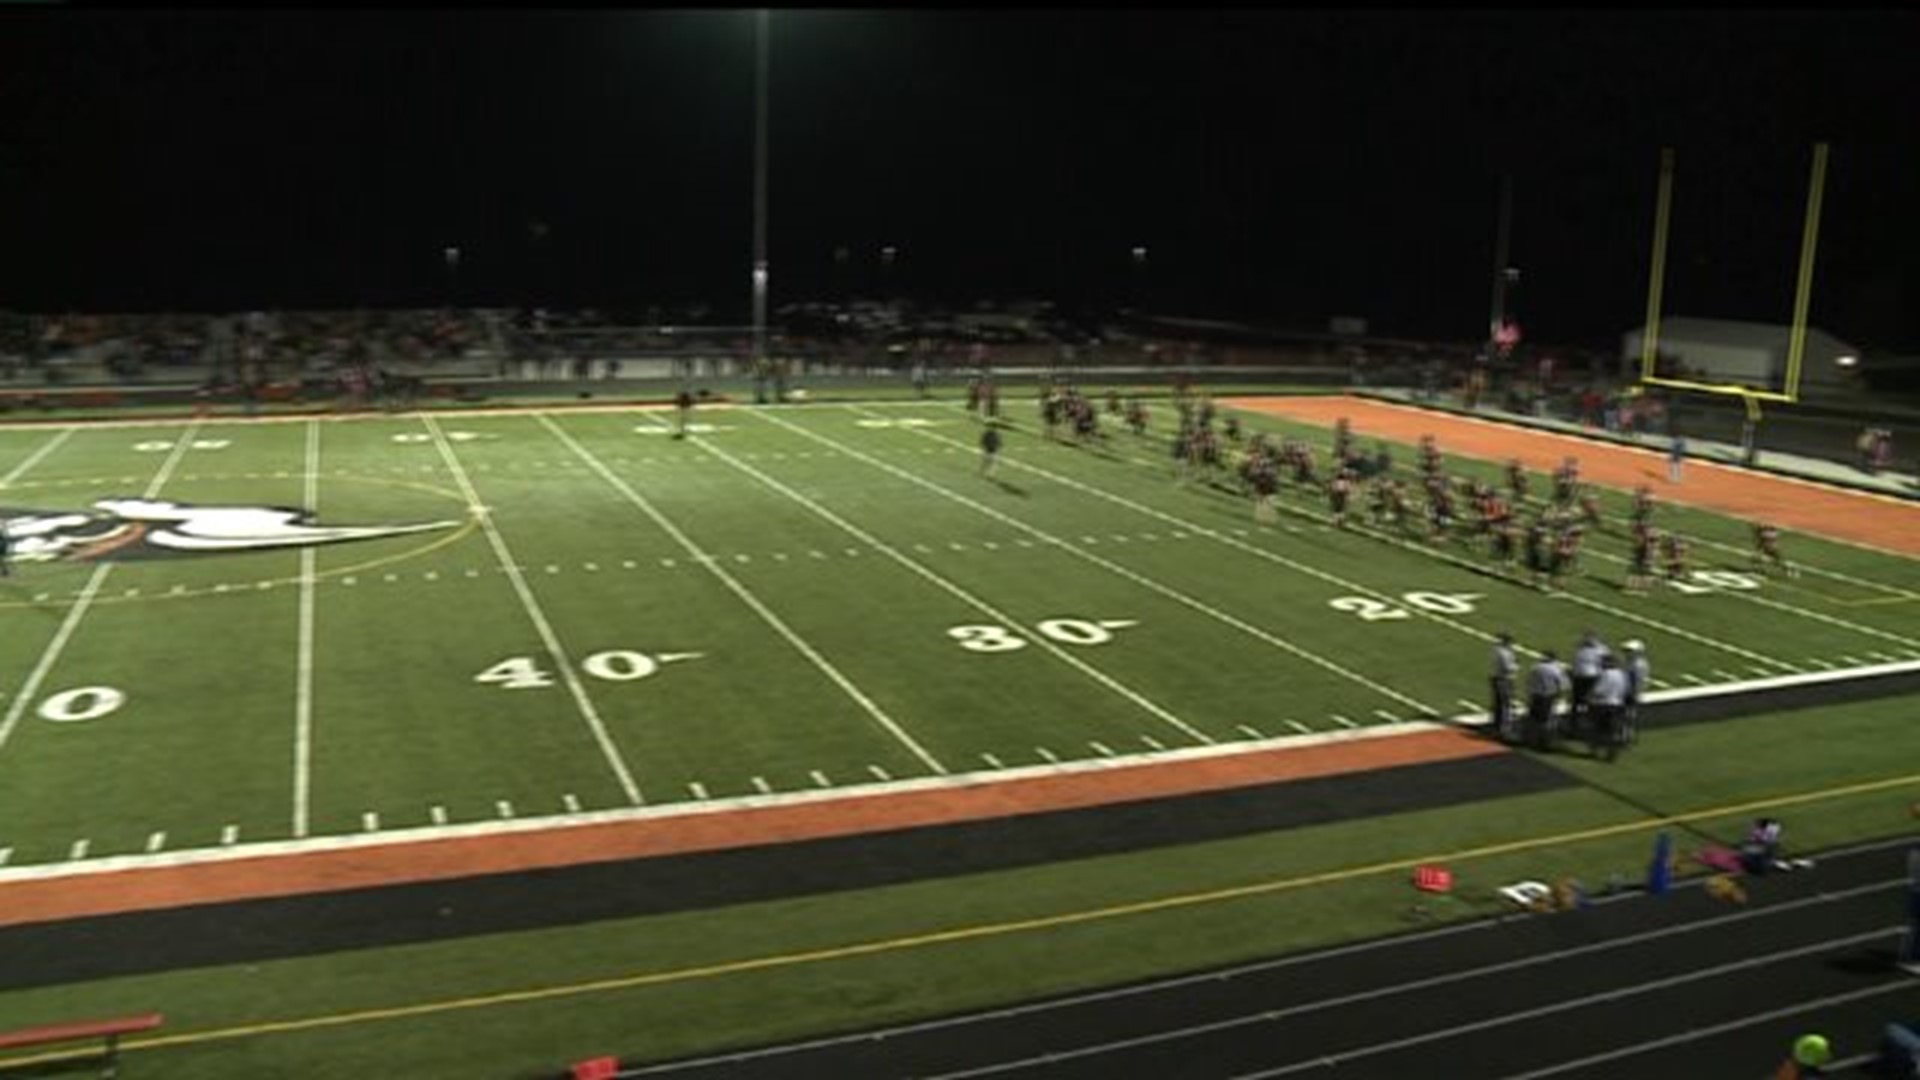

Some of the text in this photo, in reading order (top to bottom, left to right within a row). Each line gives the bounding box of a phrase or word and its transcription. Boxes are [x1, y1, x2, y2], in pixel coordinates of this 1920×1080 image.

[1328, 592, 1474, 620] 20
[946, 619, 1112, 652] 30
[474, 650, 657, 688] 40
